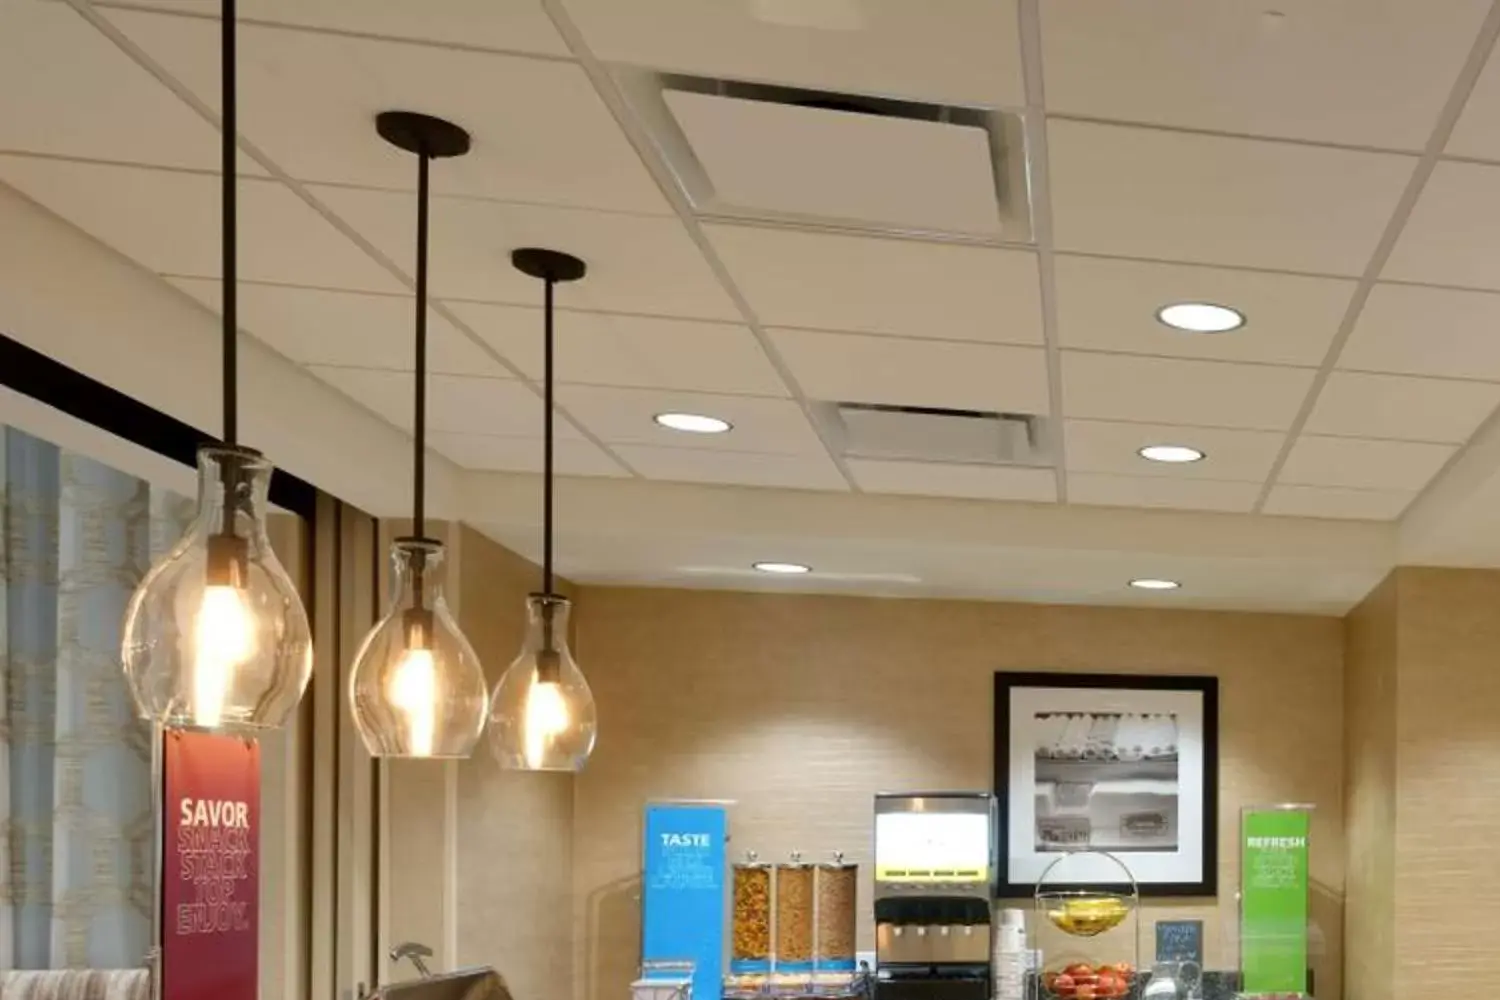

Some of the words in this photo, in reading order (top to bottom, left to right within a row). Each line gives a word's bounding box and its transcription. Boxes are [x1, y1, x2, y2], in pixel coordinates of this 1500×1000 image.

[180, 797, 250, 828] SAVOR
[660, 832, 711, 848] TASTE
[1246, 836, 1306, 849] REFRESH
